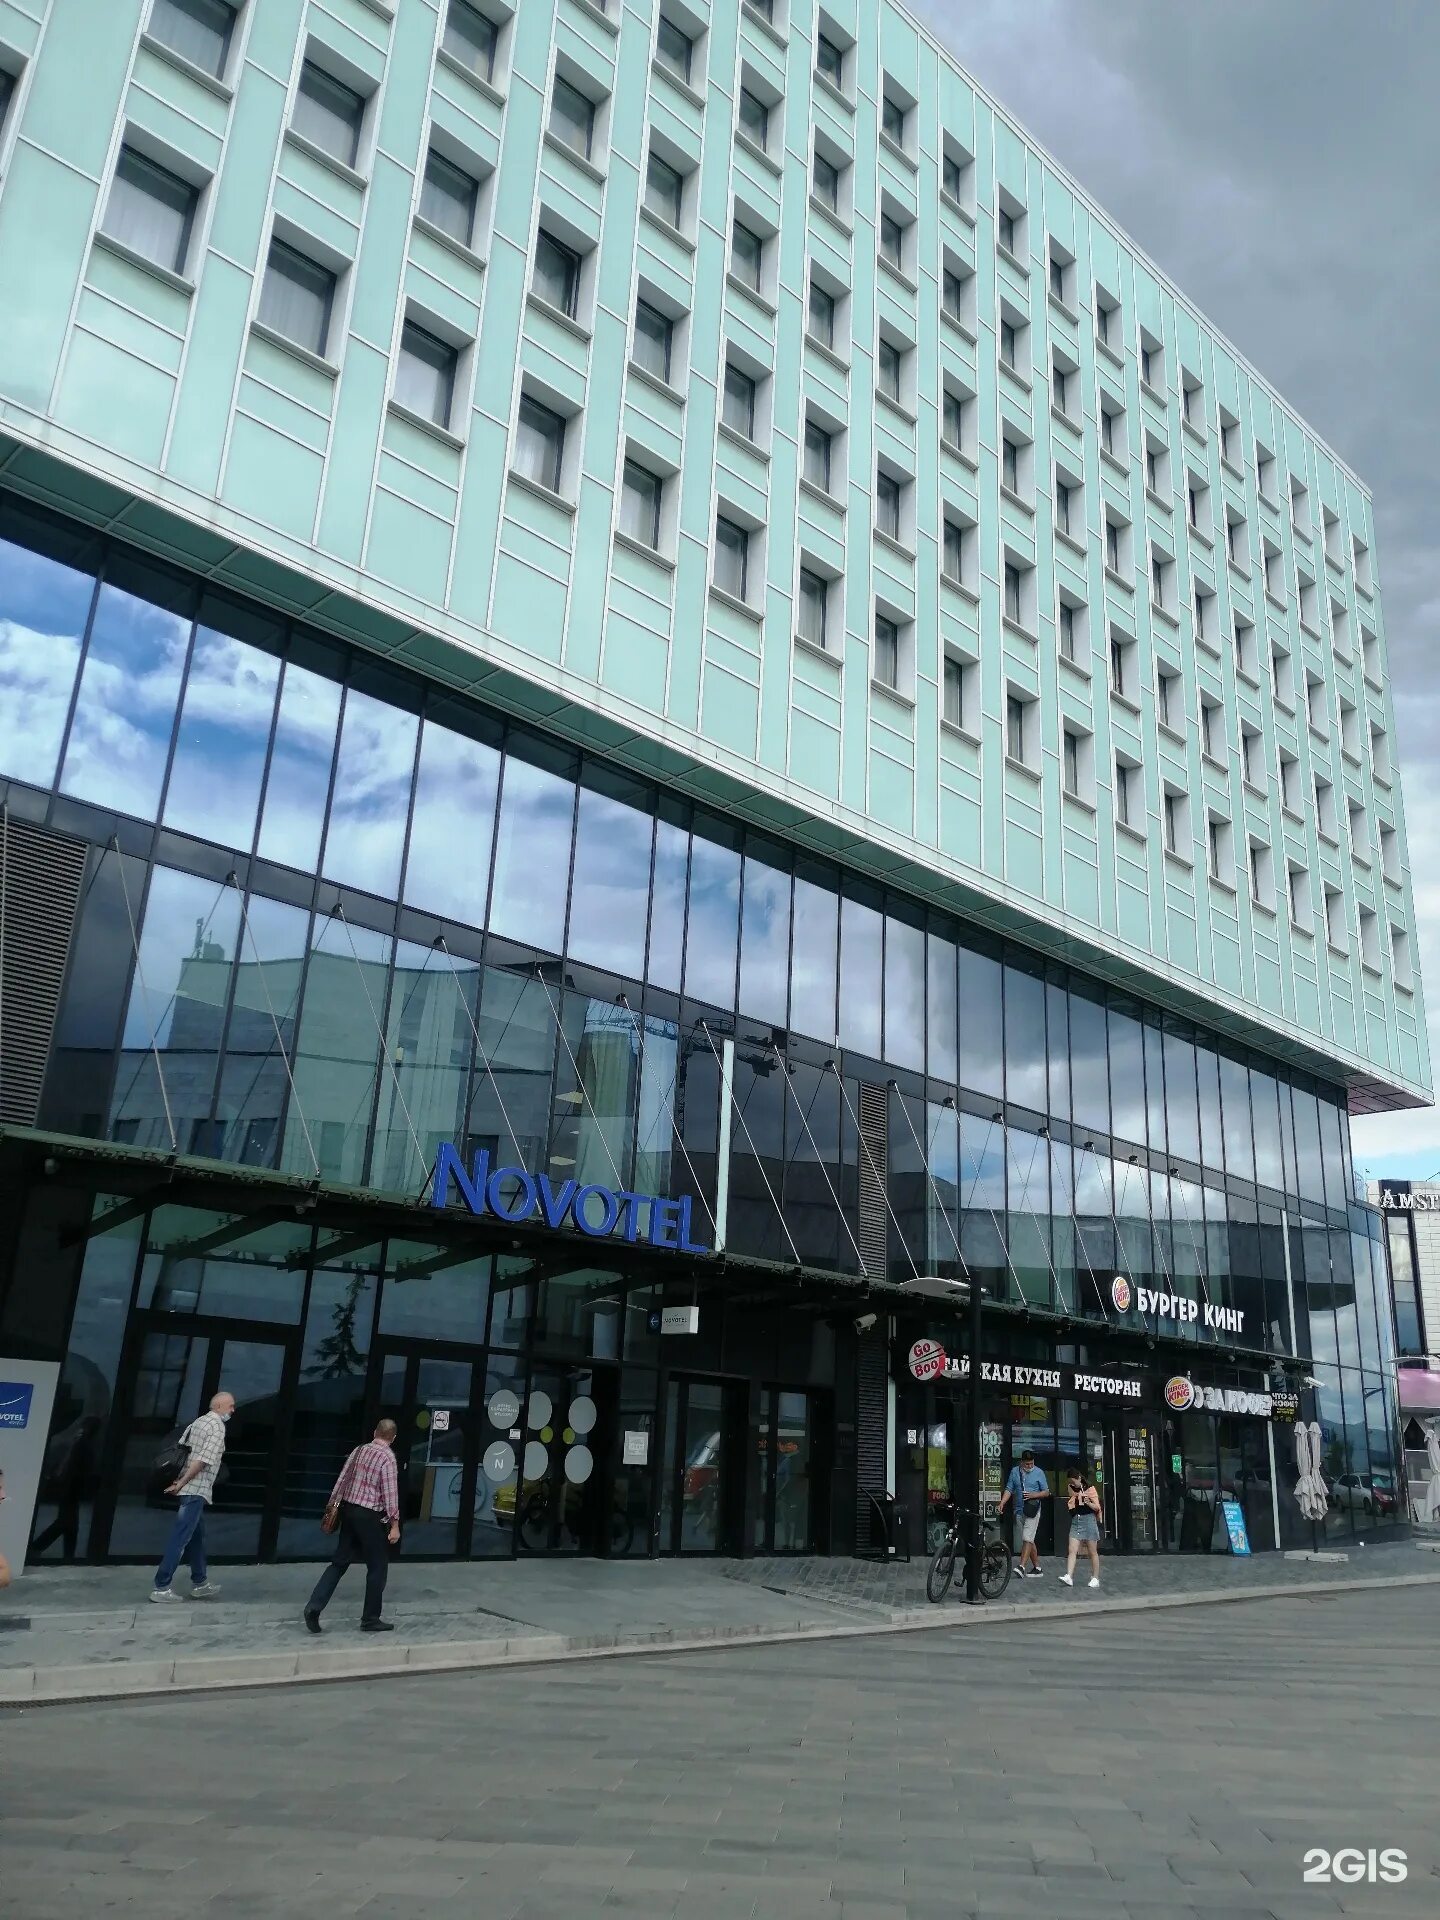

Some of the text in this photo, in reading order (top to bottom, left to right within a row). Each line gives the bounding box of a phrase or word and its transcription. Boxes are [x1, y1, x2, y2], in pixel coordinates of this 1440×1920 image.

[431, 1141, 708, 1254] NOVOTEL
[1137, 1287, 1245, 1332] БУРГЕР КИНГ
[915, 1360, 939, 1377] Boo
[1015, 1366, 1061, 1388] КУХНЯ
[1074, 1374, 1141, 1397] РЕСТОРАН
[1167, 1384, 1189, 1394] BURGER
[1168, 1389, 1190, 1402] KING
